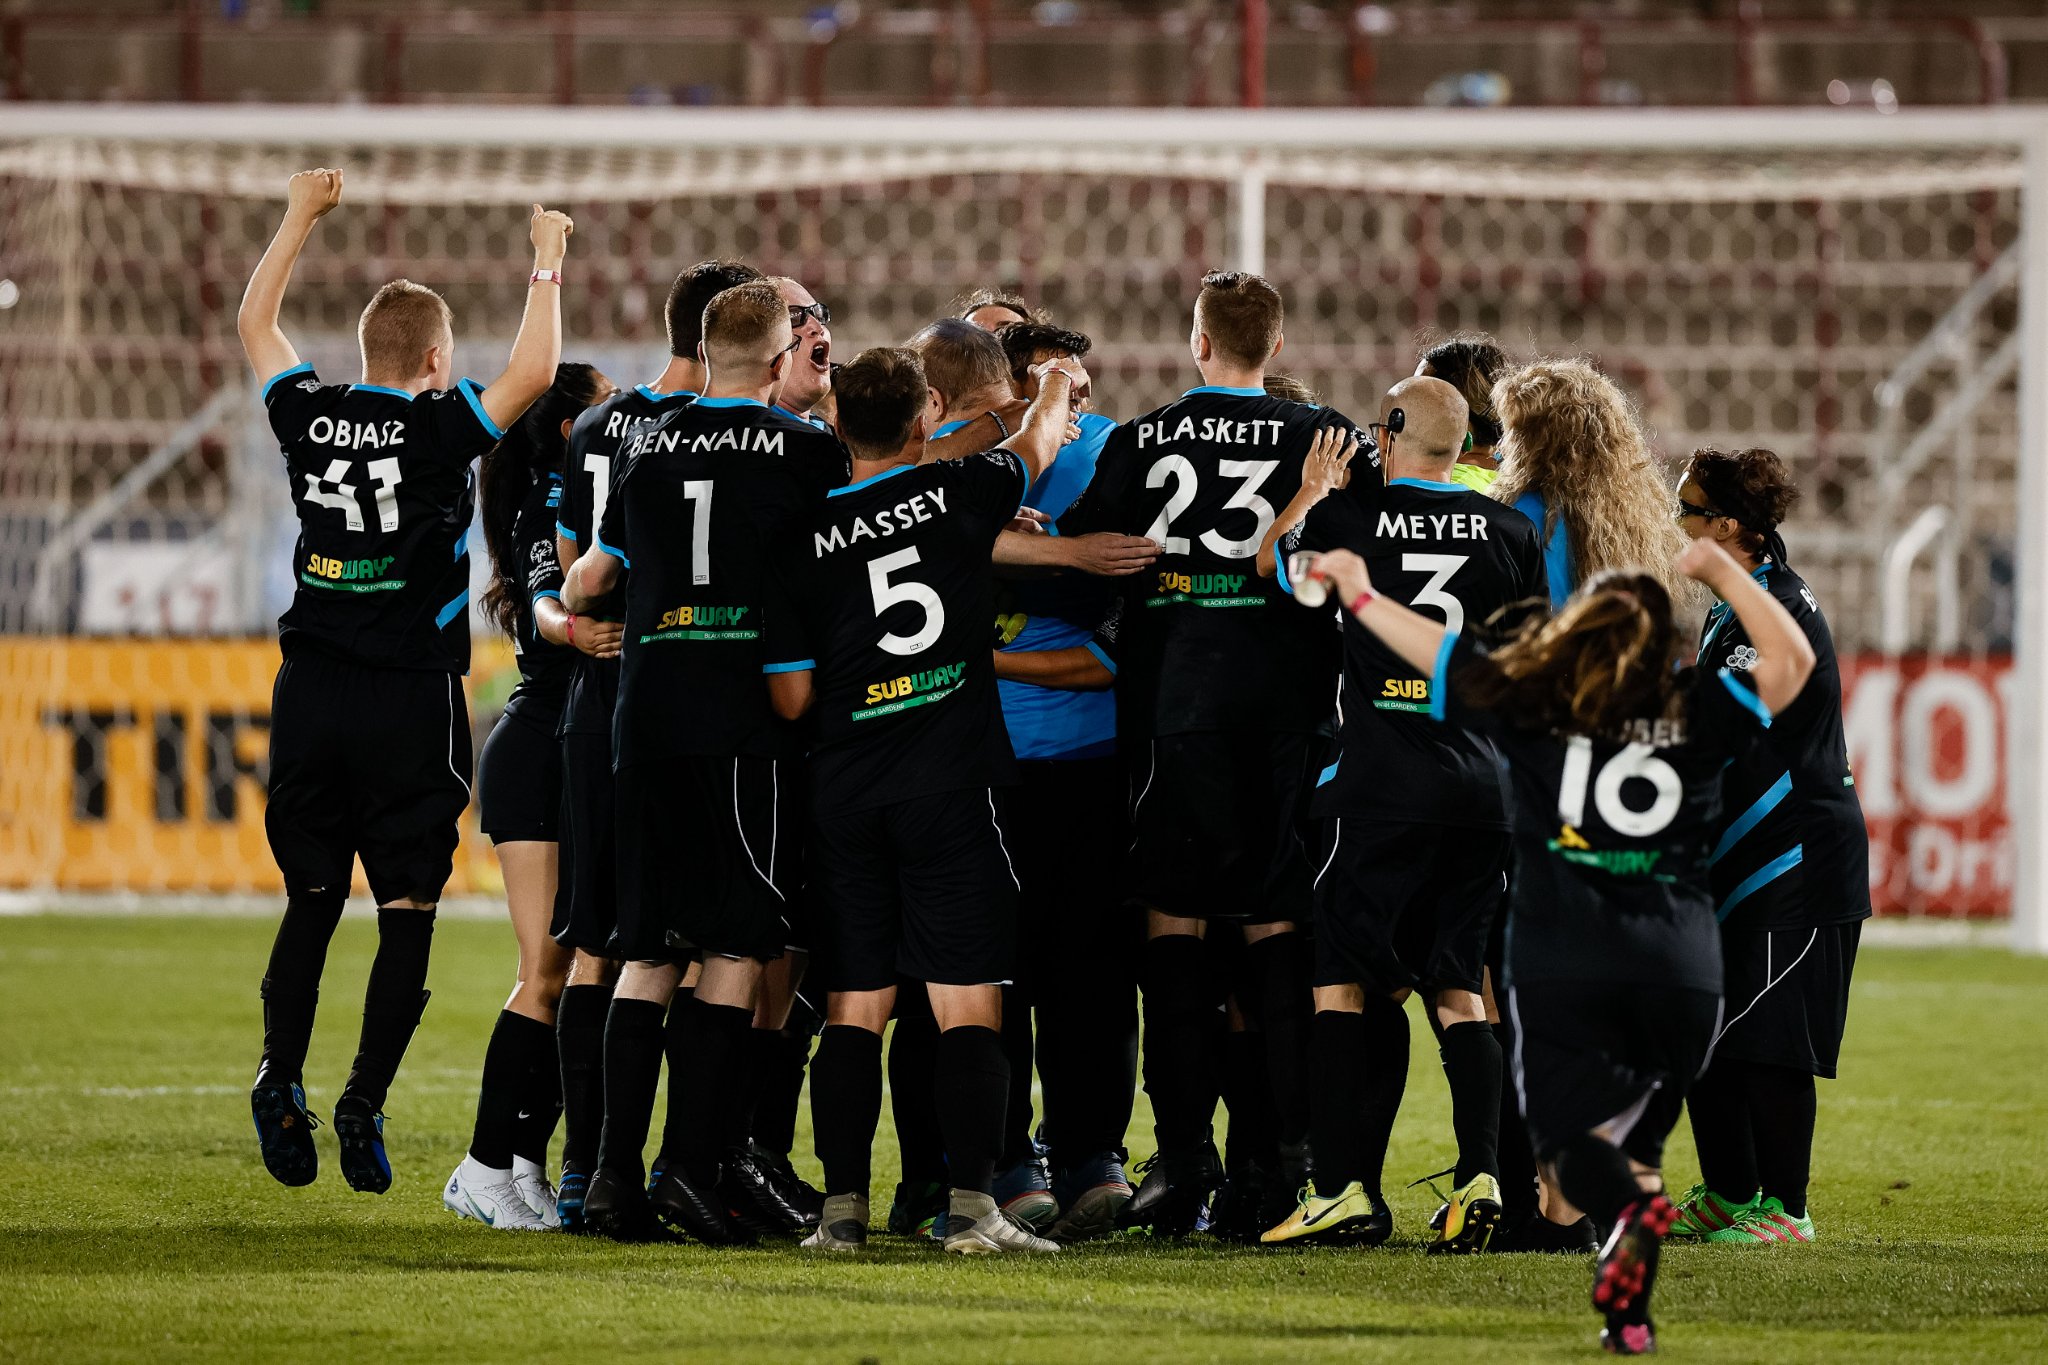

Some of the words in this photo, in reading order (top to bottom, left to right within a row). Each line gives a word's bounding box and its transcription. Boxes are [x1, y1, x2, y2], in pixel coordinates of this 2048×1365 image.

[308, 416, 405, 450] OBIASZ
[628, 427, 785, 459] BEN-NAIM
[1138, 416, 1285, 449] PLASKETT
[303, 456, 403, 533] 41
[1143, 453, 1281, 559] 23
[683, 479, 714, 586] 1
[813, 487, 948, 558] MASSEY
[1375, 511, 1489, 541] MEYER
[306, 553, 396, 580] SUBWAY
[1157, 571, 1247, 594] SUBWAY
[866, 544, 945, 656] 5
[1401, 553, 1470, 635] 3
[656, 605, 750, 631] SUBWAY
[865, 660, 967, 706] SUBWAY
[1557, 734, 1684, 838] 16
